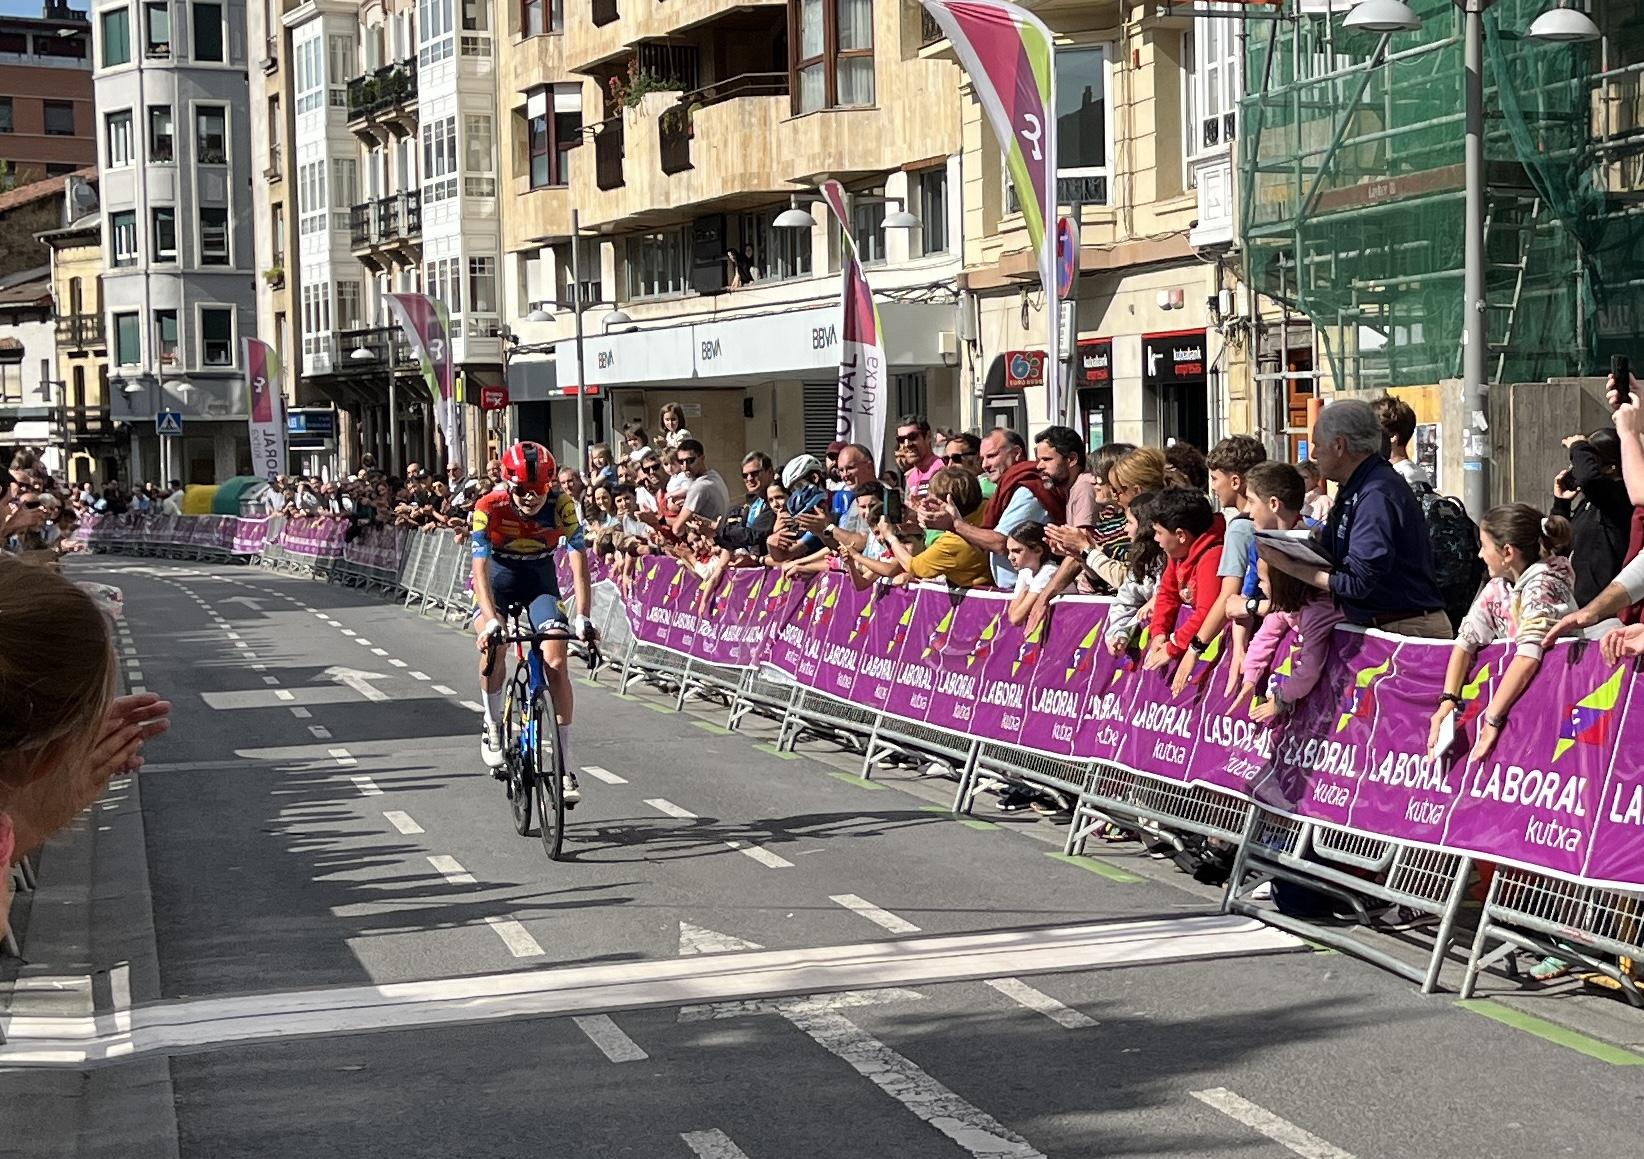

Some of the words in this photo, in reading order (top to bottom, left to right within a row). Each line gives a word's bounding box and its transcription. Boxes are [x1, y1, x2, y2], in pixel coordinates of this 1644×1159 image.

[701, 338, 722, 361] BBVA
[812, 324, 837, 350] BBVA
[598, 349, 615, 369] BBVA
[836, 353, 858, 436] ORAL
[858, 356, 879, 417] kutxa
[823, 642, 858, 672] LABORAL
[896, 662, 932, 690] LABORAL
[937, 671, 976, 700] LABORAL
[981, 679, 1024, 709] LABORAL
[1031, 686, 1079, 718] LABORAL
[1131, 700, 1192, 739] LABORAL
[1152, 738, 1186, 765] kutxa
[1204, 713, 1274, 760] LABORAL
[1284, 735, 1358, 778] LABORAL
[1368, 748, 1453, 794] LABORAL
[1313, 778, 1350, 808] kutxa
[1470, 761, 1588, 817] LABORAL
[1609, 782, 1644, 826] LA
[1405, 796, 1445, 825] kutxa
[1524, 814, 1582, 852] kutxa
